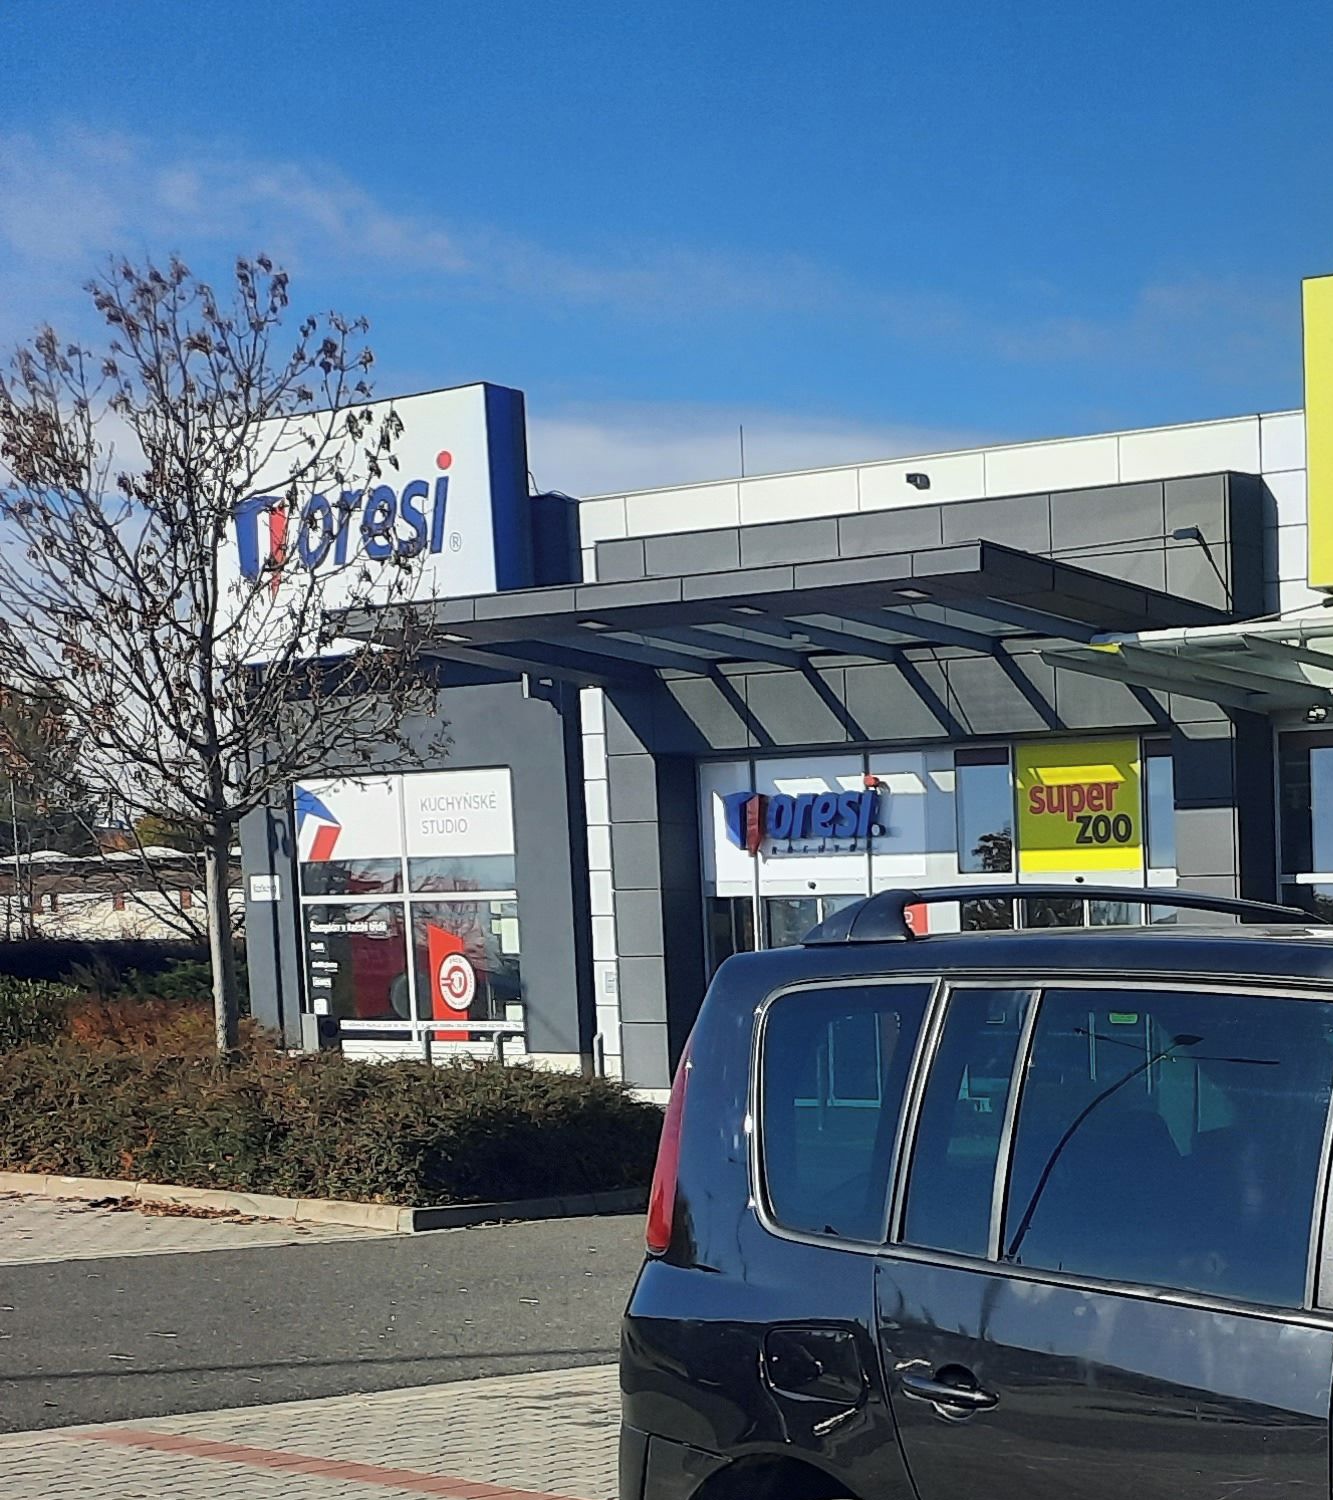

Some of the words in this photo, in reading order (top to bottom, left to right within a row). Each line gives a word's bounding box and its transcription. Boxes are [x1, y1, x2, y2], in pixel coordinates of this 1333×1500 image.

[420, 790, 497, 812] KUCHYŇSKÉ
[1028, 782, 1119, 822] super
[421, 818, 468, 835] STUDIO
[1075, 814, 1132, 844] zoo
